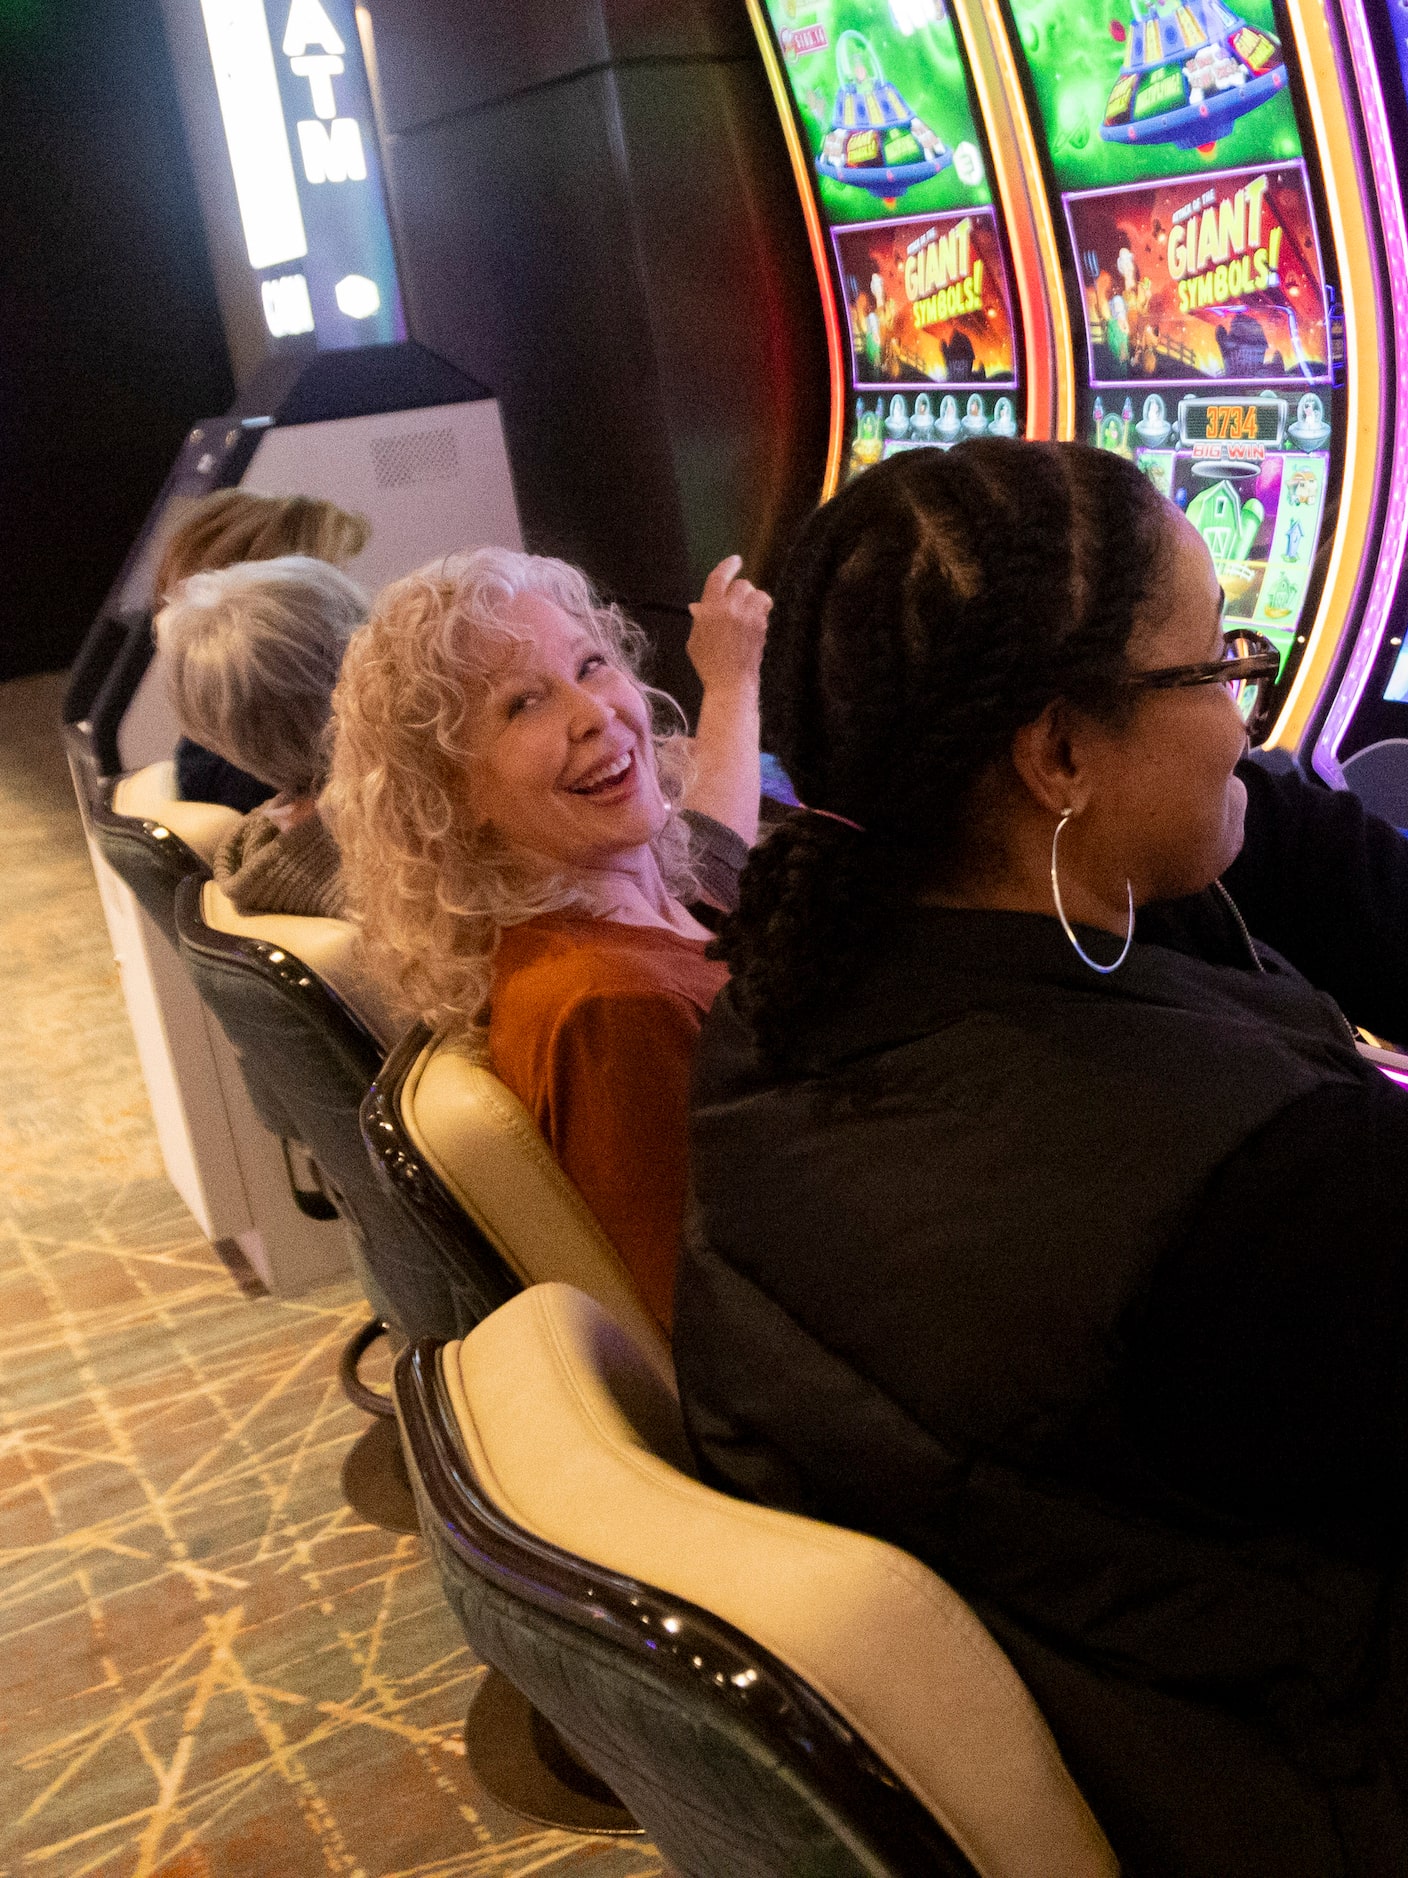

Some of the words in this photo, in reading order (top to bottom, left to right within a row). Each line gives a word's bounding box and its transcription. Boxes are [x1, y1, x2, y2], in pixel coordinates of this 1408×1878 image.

[283, 0, 367, 184] ATM
[905, 217, 972, 301] GIANT
[1167, 174, 1268, 281] GIANT
[1178, 226, 1283, 313] SYMBOLS!
[913, 260, 983, 328] SYMBOLS!
[1192, 443, 1222, 458] BIG
[1227, 445, 1265, 460] WIN
[1206, 405, 1258, 439] 3734
